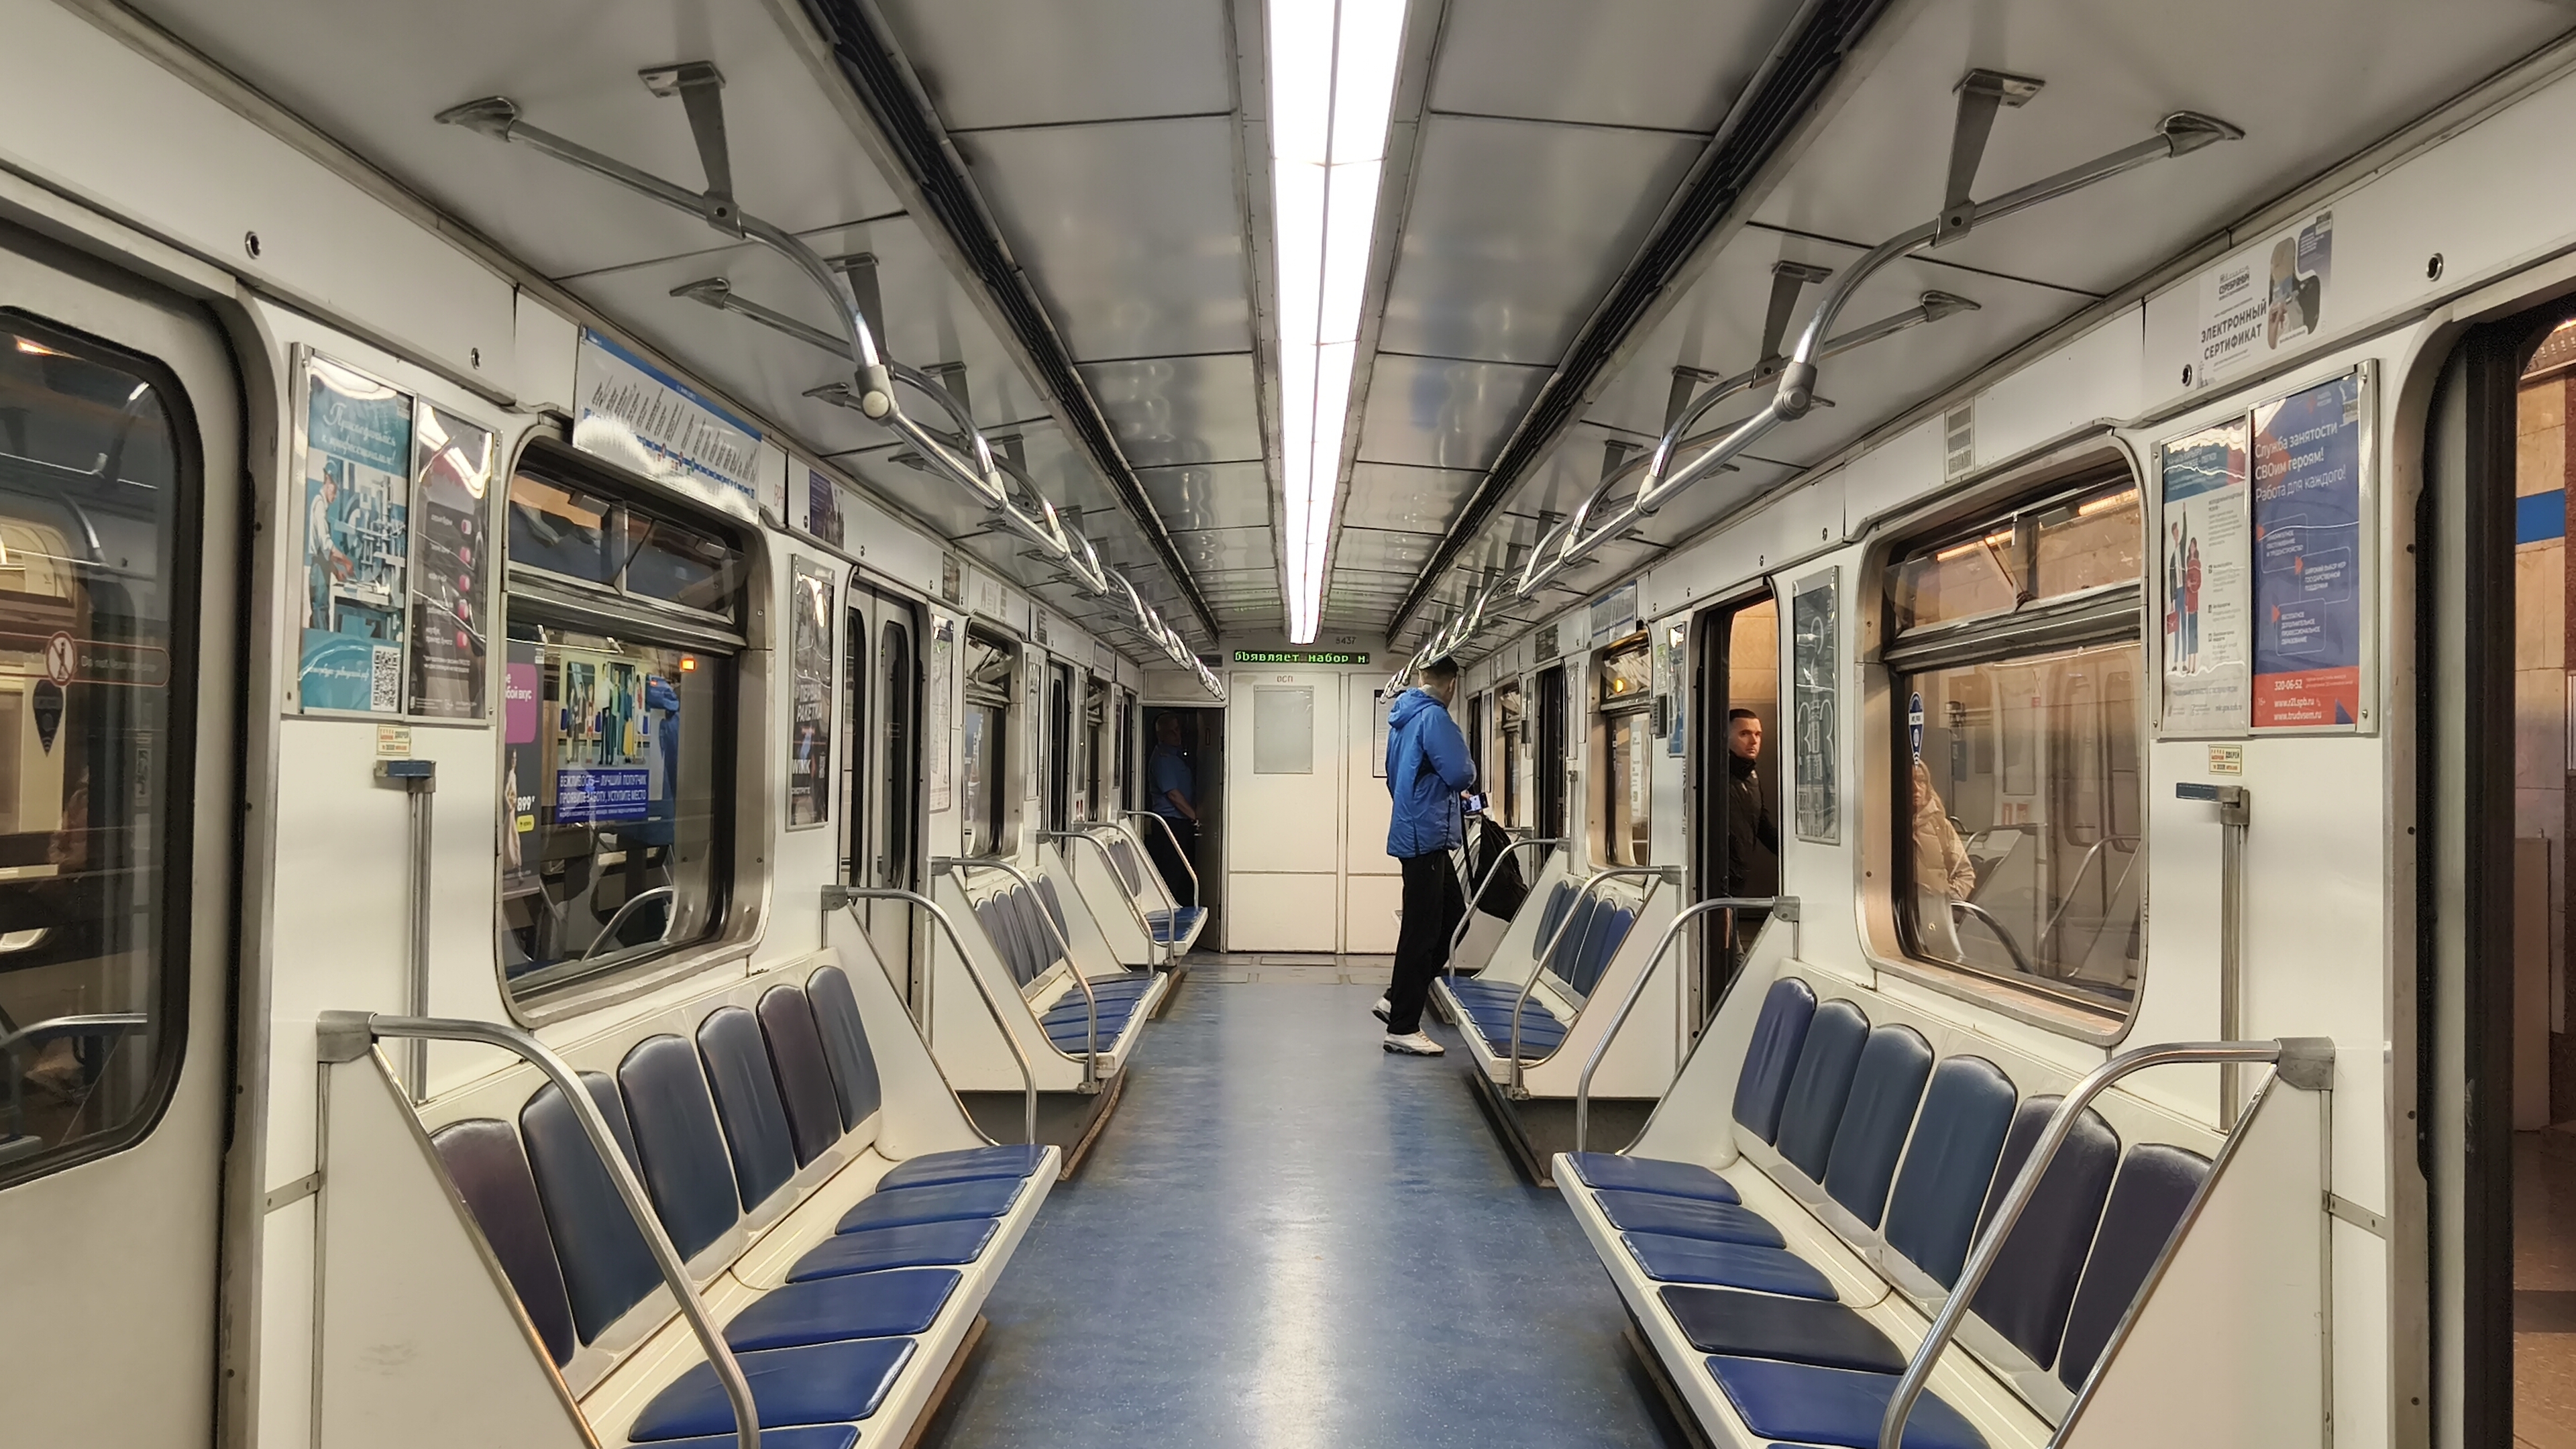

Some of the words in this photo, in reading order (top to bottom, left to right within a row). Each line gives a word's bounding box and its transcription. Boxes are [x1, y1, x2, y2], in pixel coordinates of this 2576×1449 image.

[2201, 297, 2267, 343] ЭЛЕКТРОННЫЙ
[2204, 323, 2262, 360] СЕРТИФИКАТ
[2255, 435, 2288, 459] Служба
[2290, 422, 2338, 448] занятости
[2255, 462, 2287, 480] СВОим
[2288, 446, 2324, 472] героям!
[2255, 484, 2286, 502] Работа
[2287, 478, 2303, 496] для
[2304, 464, 2347, 489] каждого!
[1308, 653, 1348, 663] набор
[1277, 675, 1293, 683] ОСП
[2274, 679, 2302, 690] 320-06-52
[519, 690, 532, 702] вкус
[796, 704, 822, 722] РАКЕТКА
[600, 772, 622, 786] ЛУЧШИЙ
[623, 774, 647, 786] ПОПУТЧИК
[631, 790, 646, 800] МЕСТО
